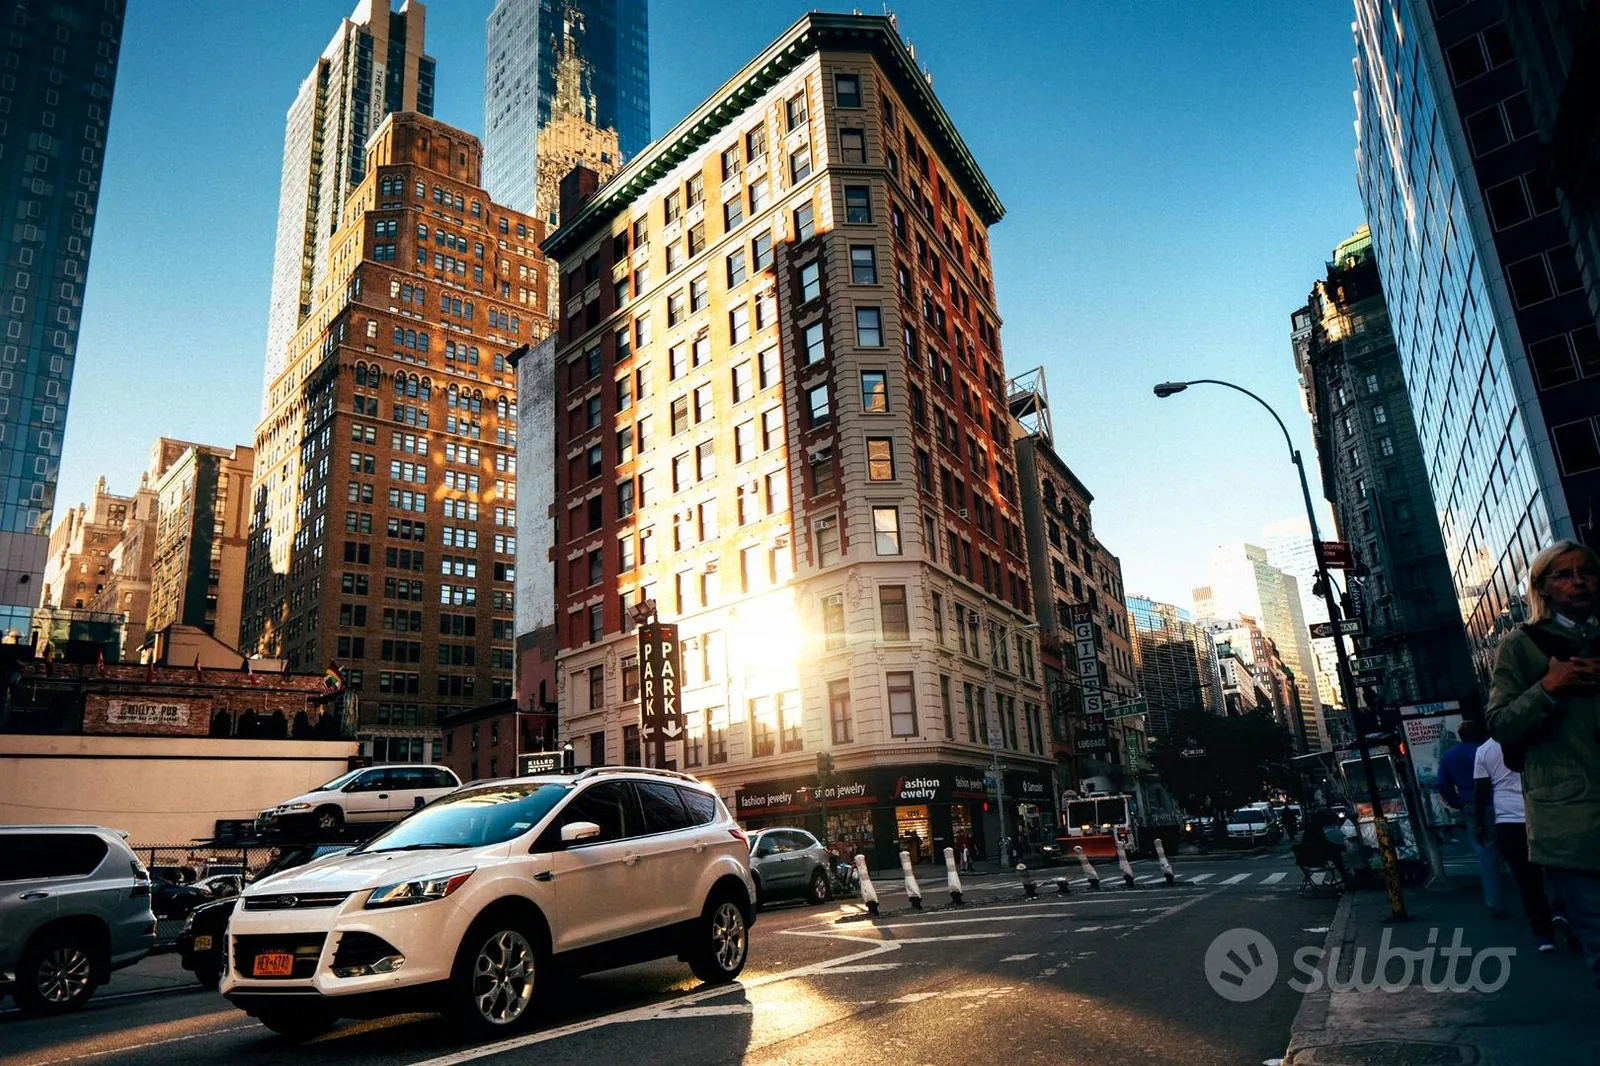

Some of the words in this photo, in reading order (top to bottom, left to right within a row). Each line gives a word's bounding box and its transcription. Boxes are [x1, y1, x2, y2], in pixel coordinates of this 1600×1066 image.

[1073, 613, 1089, 621] NY
[1076, 624, 1100, 711] GIFTS
[1352, 660, 1360, 670] W
[1363, 657, 1373, 669] 31
[644, 643, 655, 717] PARK
[661, 641, 677, 715] PARK
[161, 705, 178, 716] PUB
[1415, 703, 1445, 713] TITAN
[1077, 738, 1107, 749] LUGGAGE
[527, 758, 554, 766] KILLED
[836, 782, 866, 798] jewelry
[741, 795, 766, 807] fashion
[766, 791, 792, 806] jewelry
